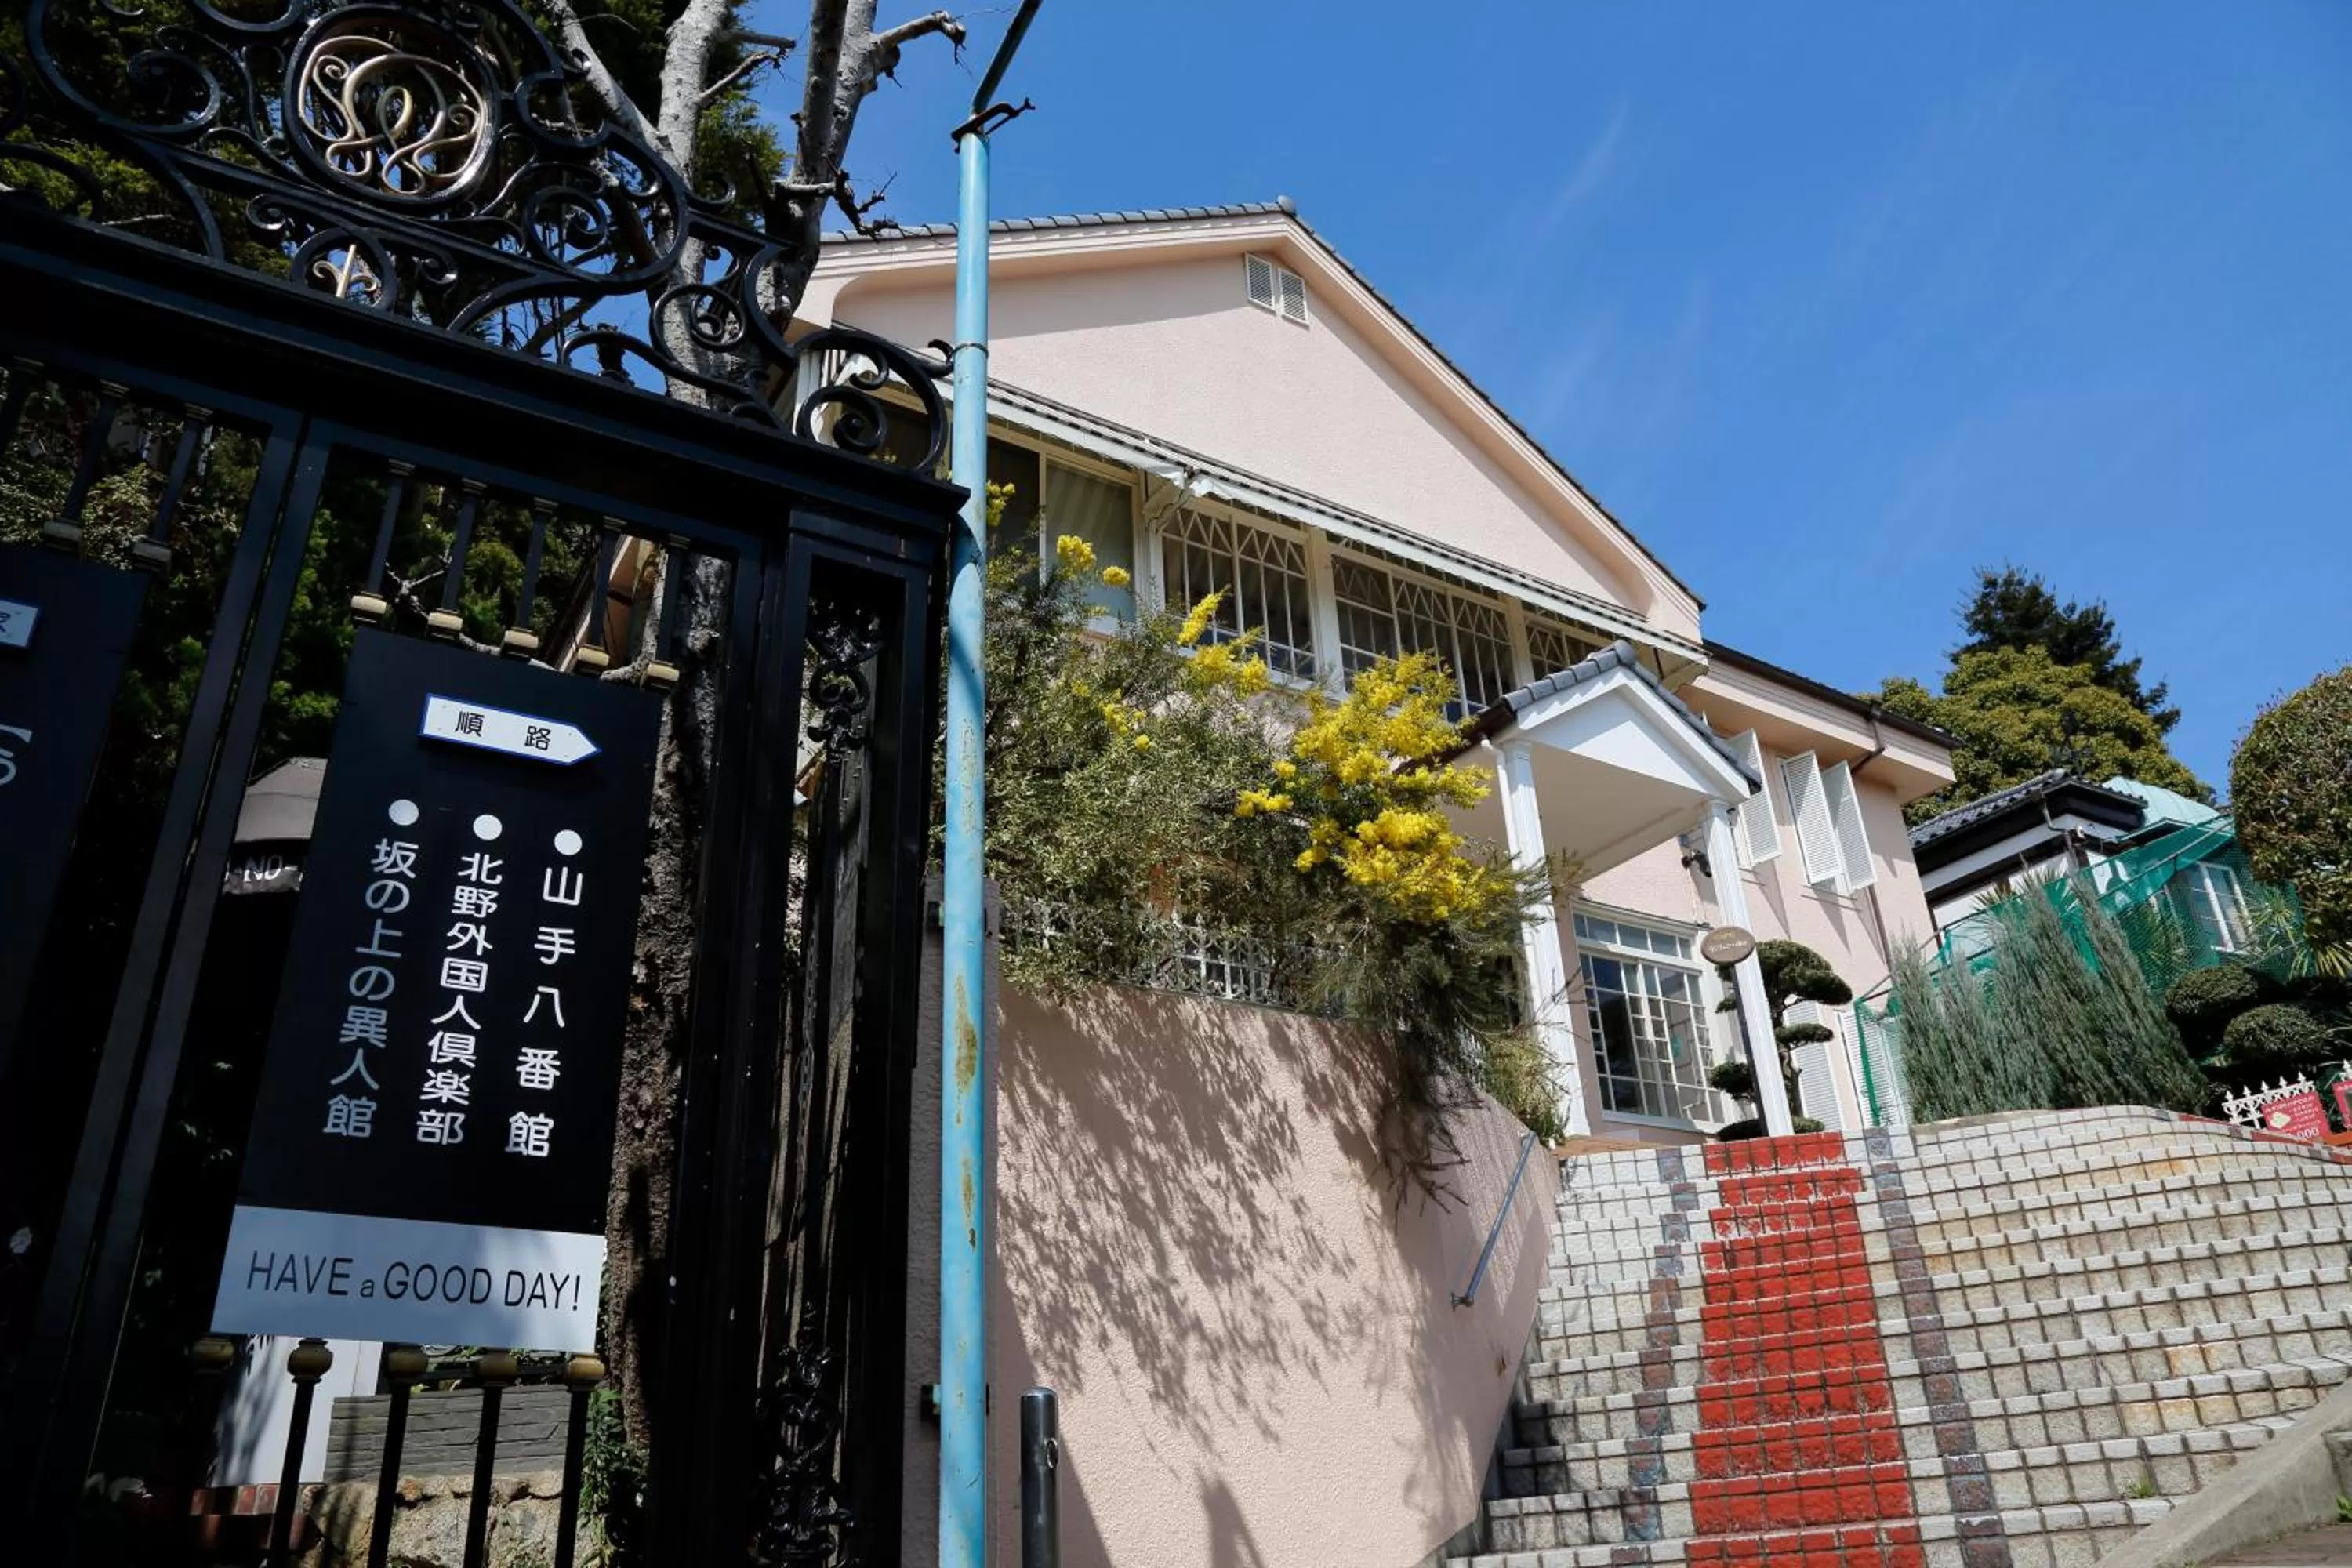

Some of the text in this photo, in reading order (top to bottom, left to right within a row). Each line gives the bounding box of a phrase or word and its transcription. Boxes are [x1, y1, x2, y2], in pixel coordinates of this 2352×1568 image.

[455, 711, 551, 750] 順路
[322, 838, 419, 1138] 坂の上の異人館
[416, 852, 503, 1145] 北野外国人倶楽部
[505, 866, 583, 1156] 山手八番館
[247, 1250, 581, 1310] HAVE a GOOD DAY!
